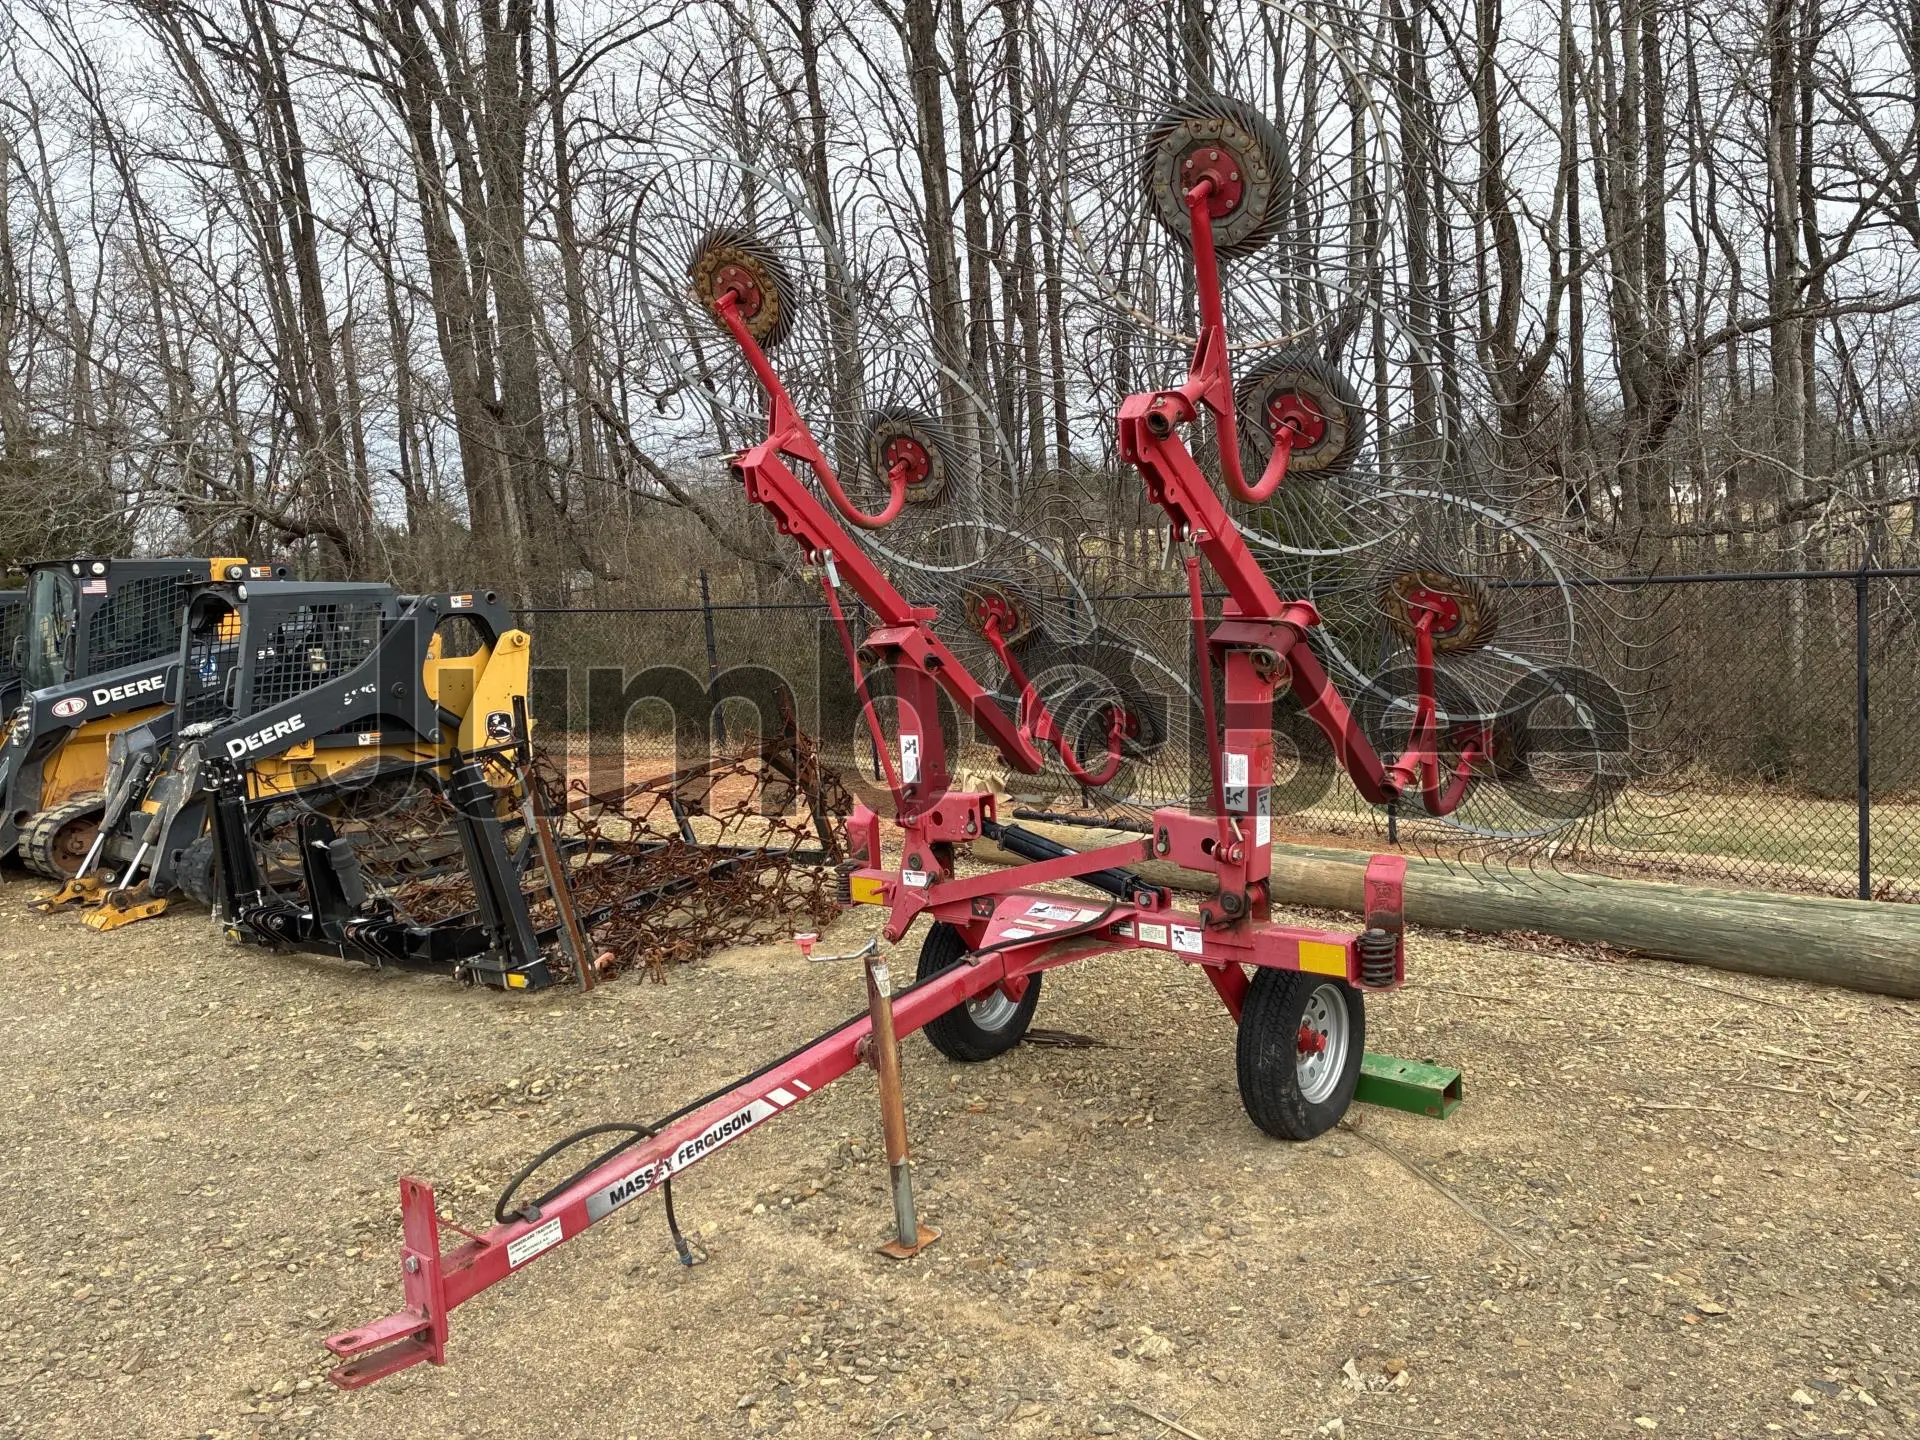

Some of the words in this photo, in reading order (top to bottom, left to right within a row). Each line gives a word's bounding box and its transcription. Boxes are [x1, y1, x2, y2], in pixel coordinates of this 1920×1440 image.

[92, 675, 165, 706] DEERE
[225, 713, 306, 759] DEERE
[678, 1110, 752, 1164] FERGUSON
